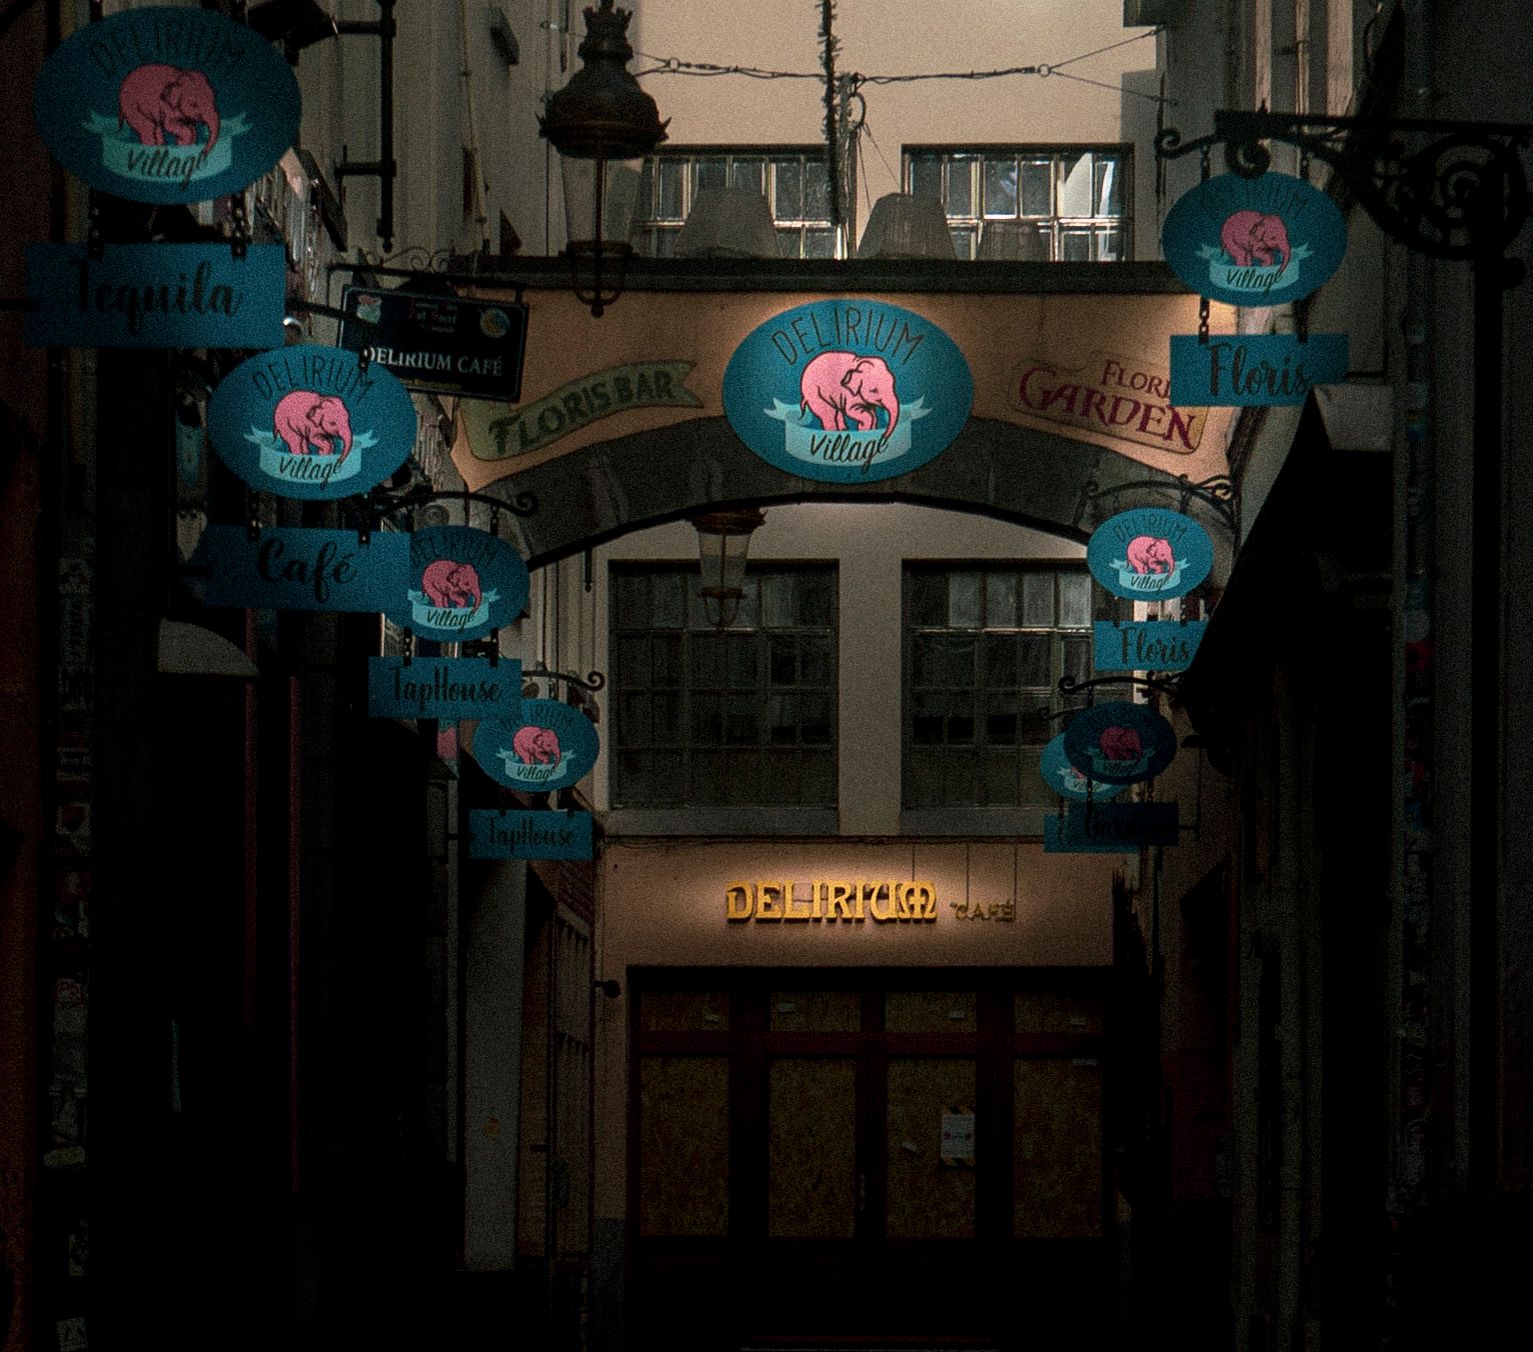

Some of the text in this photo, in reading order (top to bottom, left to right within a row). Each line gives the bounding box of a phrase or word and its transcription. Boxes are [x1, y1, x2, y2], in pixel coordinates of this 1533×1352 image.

[127, 148, 208, 191] Village
[69, 260, 243, 336] Tequila
[1227, 268, 1280, 295] Village
[771, 306, 924, 366] DELIRIUM
[252, 355, 374, 402] DELIRIUM
[364, 346, 504, 376] DELIRIUM CAFÉ
[1100, 359, 1171, 398] FLORI
[1206, 343, 1312, 396] Floris
[489, 370, 675, 454] FLORIS BAR
[1019, 366, 1196, 449] GARDEN
[279, 456, 341, 490] Village
[810, 434, 888, 475] Village
[258, 538, 356, 603] Café
[1131, 575, 1169, 595] Village
[426, 609, 475, 632] Village
[1120, 627, 1190, 664] Floris
[726, 879, 937, 921] DELIRIUM
